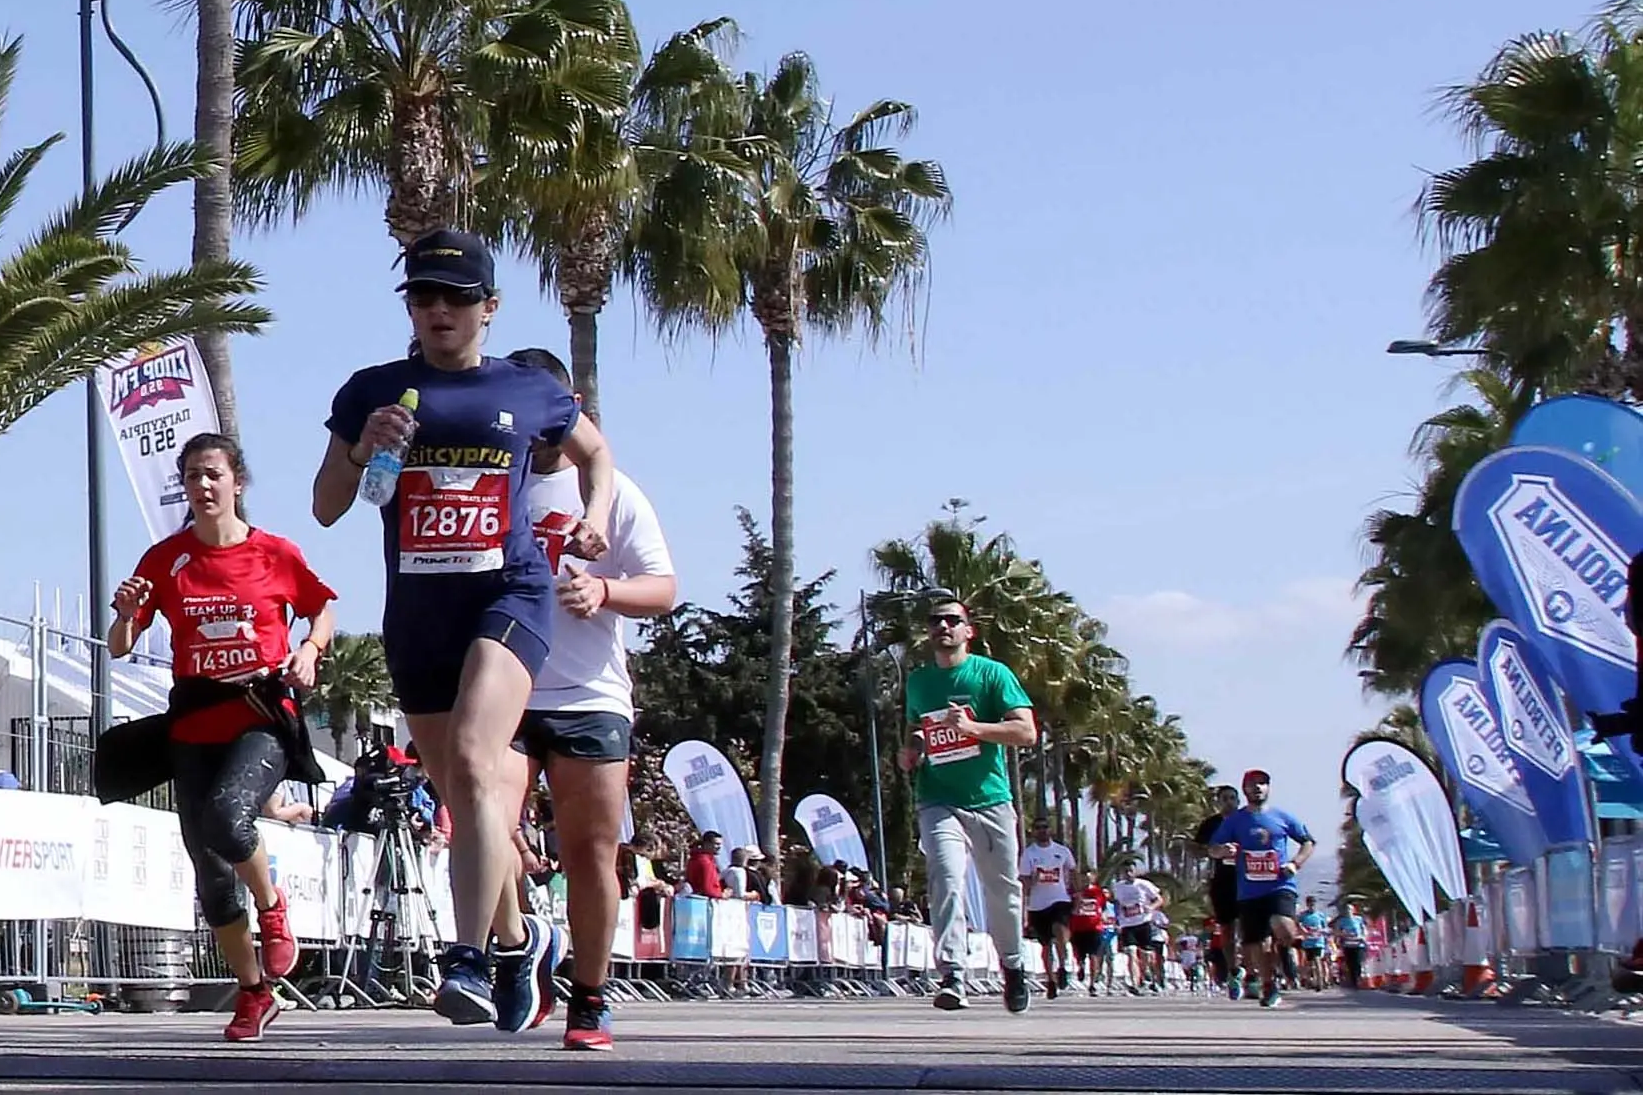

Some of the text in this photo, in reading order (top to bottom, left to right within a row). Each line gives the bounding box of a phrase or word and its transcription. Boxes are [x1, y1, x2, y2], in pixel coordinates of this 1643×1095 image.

[409, 505, 500, 537] 12876
[184, 605, 237, 617] TEAM UP
